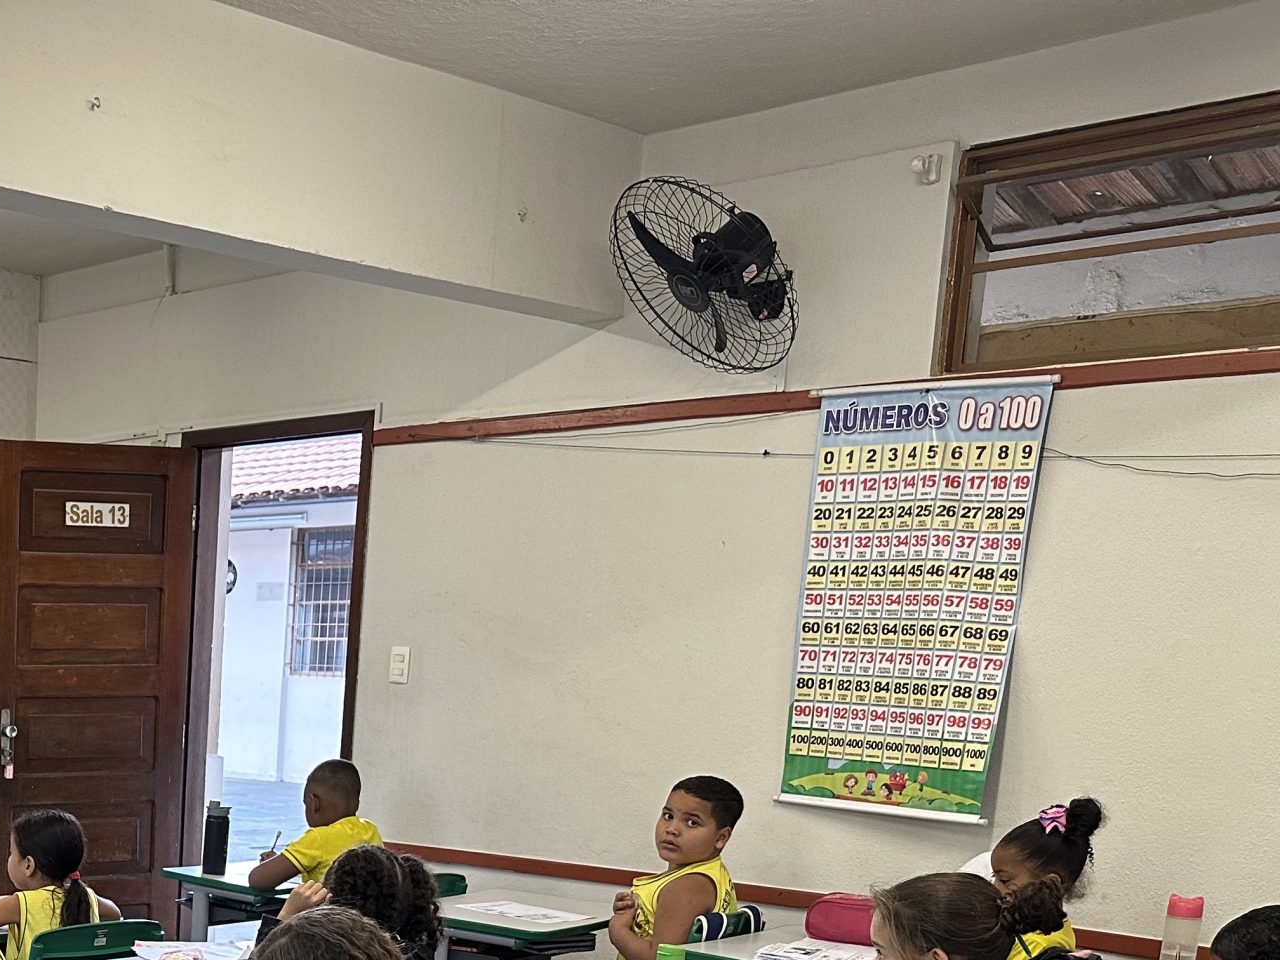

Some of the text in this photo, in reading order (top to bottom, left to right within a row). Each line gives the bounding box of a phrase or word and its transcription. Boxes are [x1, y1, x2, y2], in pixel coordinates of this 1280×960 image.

[823, 394, 1044, 434] NÚMEROS 0 a 100
[824, 445, 1032, 464] 0 1 2 3 4 5 6 7 8 9
[818, 473, 1031, 493] 10 11 12 13 14 15 16 17 18 19
[70, 504, 126, 525] Sala 13
[814, 505, 1025, 520] 20 21 22 23 24 25 26 27 28 29
[811, 533, 1022, 550] 30 31 32 33 34 35 36 37 38 39
[807, 564, 1018, 581] 40 41 42 43 44 45 46 47 48 49
[791, 734, 986, 760] 100 200 300 400 500 600 700 800 900 1000
